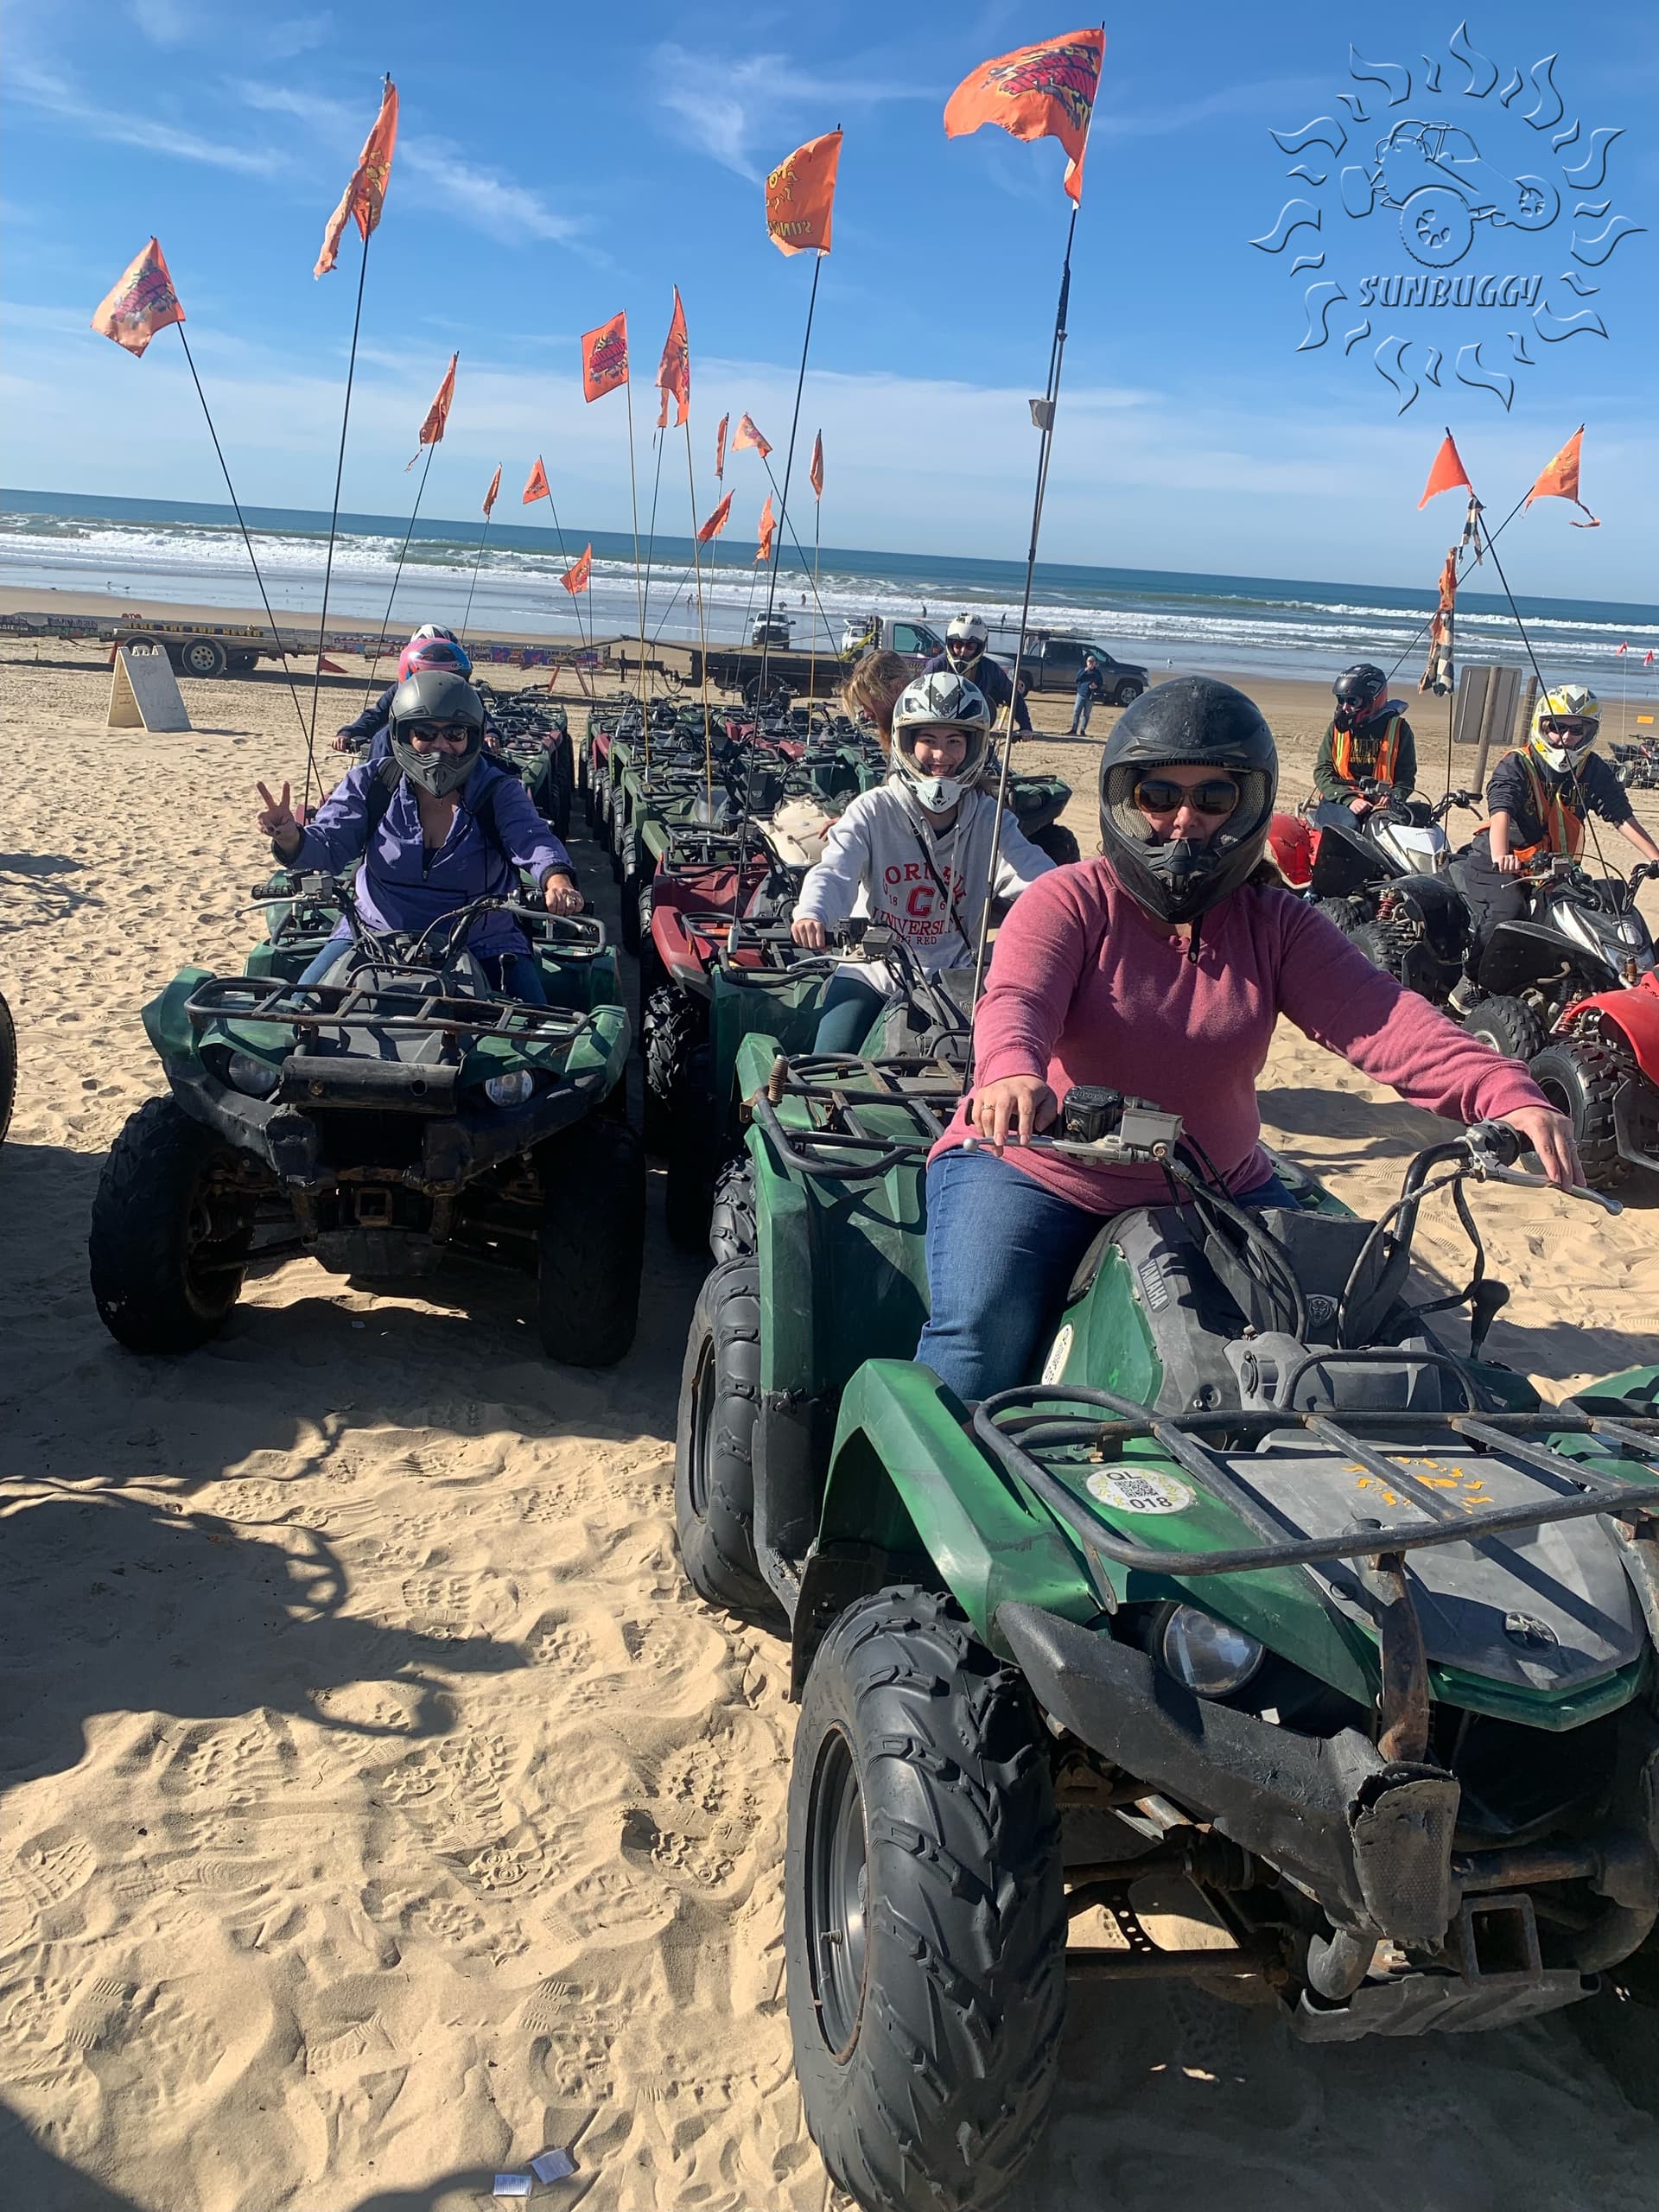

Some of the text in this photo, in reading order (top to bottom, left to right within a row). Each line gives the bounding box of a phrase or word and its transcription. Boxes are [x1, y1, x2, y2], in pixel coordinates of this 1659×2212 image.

[906, 884, 936, 918] C
[916, 936, 938, 945] RED
[1139, 1259, 1168, 1310] YAMAHA
[1106, 1471, 1143, 1481] QL
[1128, 1497, 1173, 1510] 018
